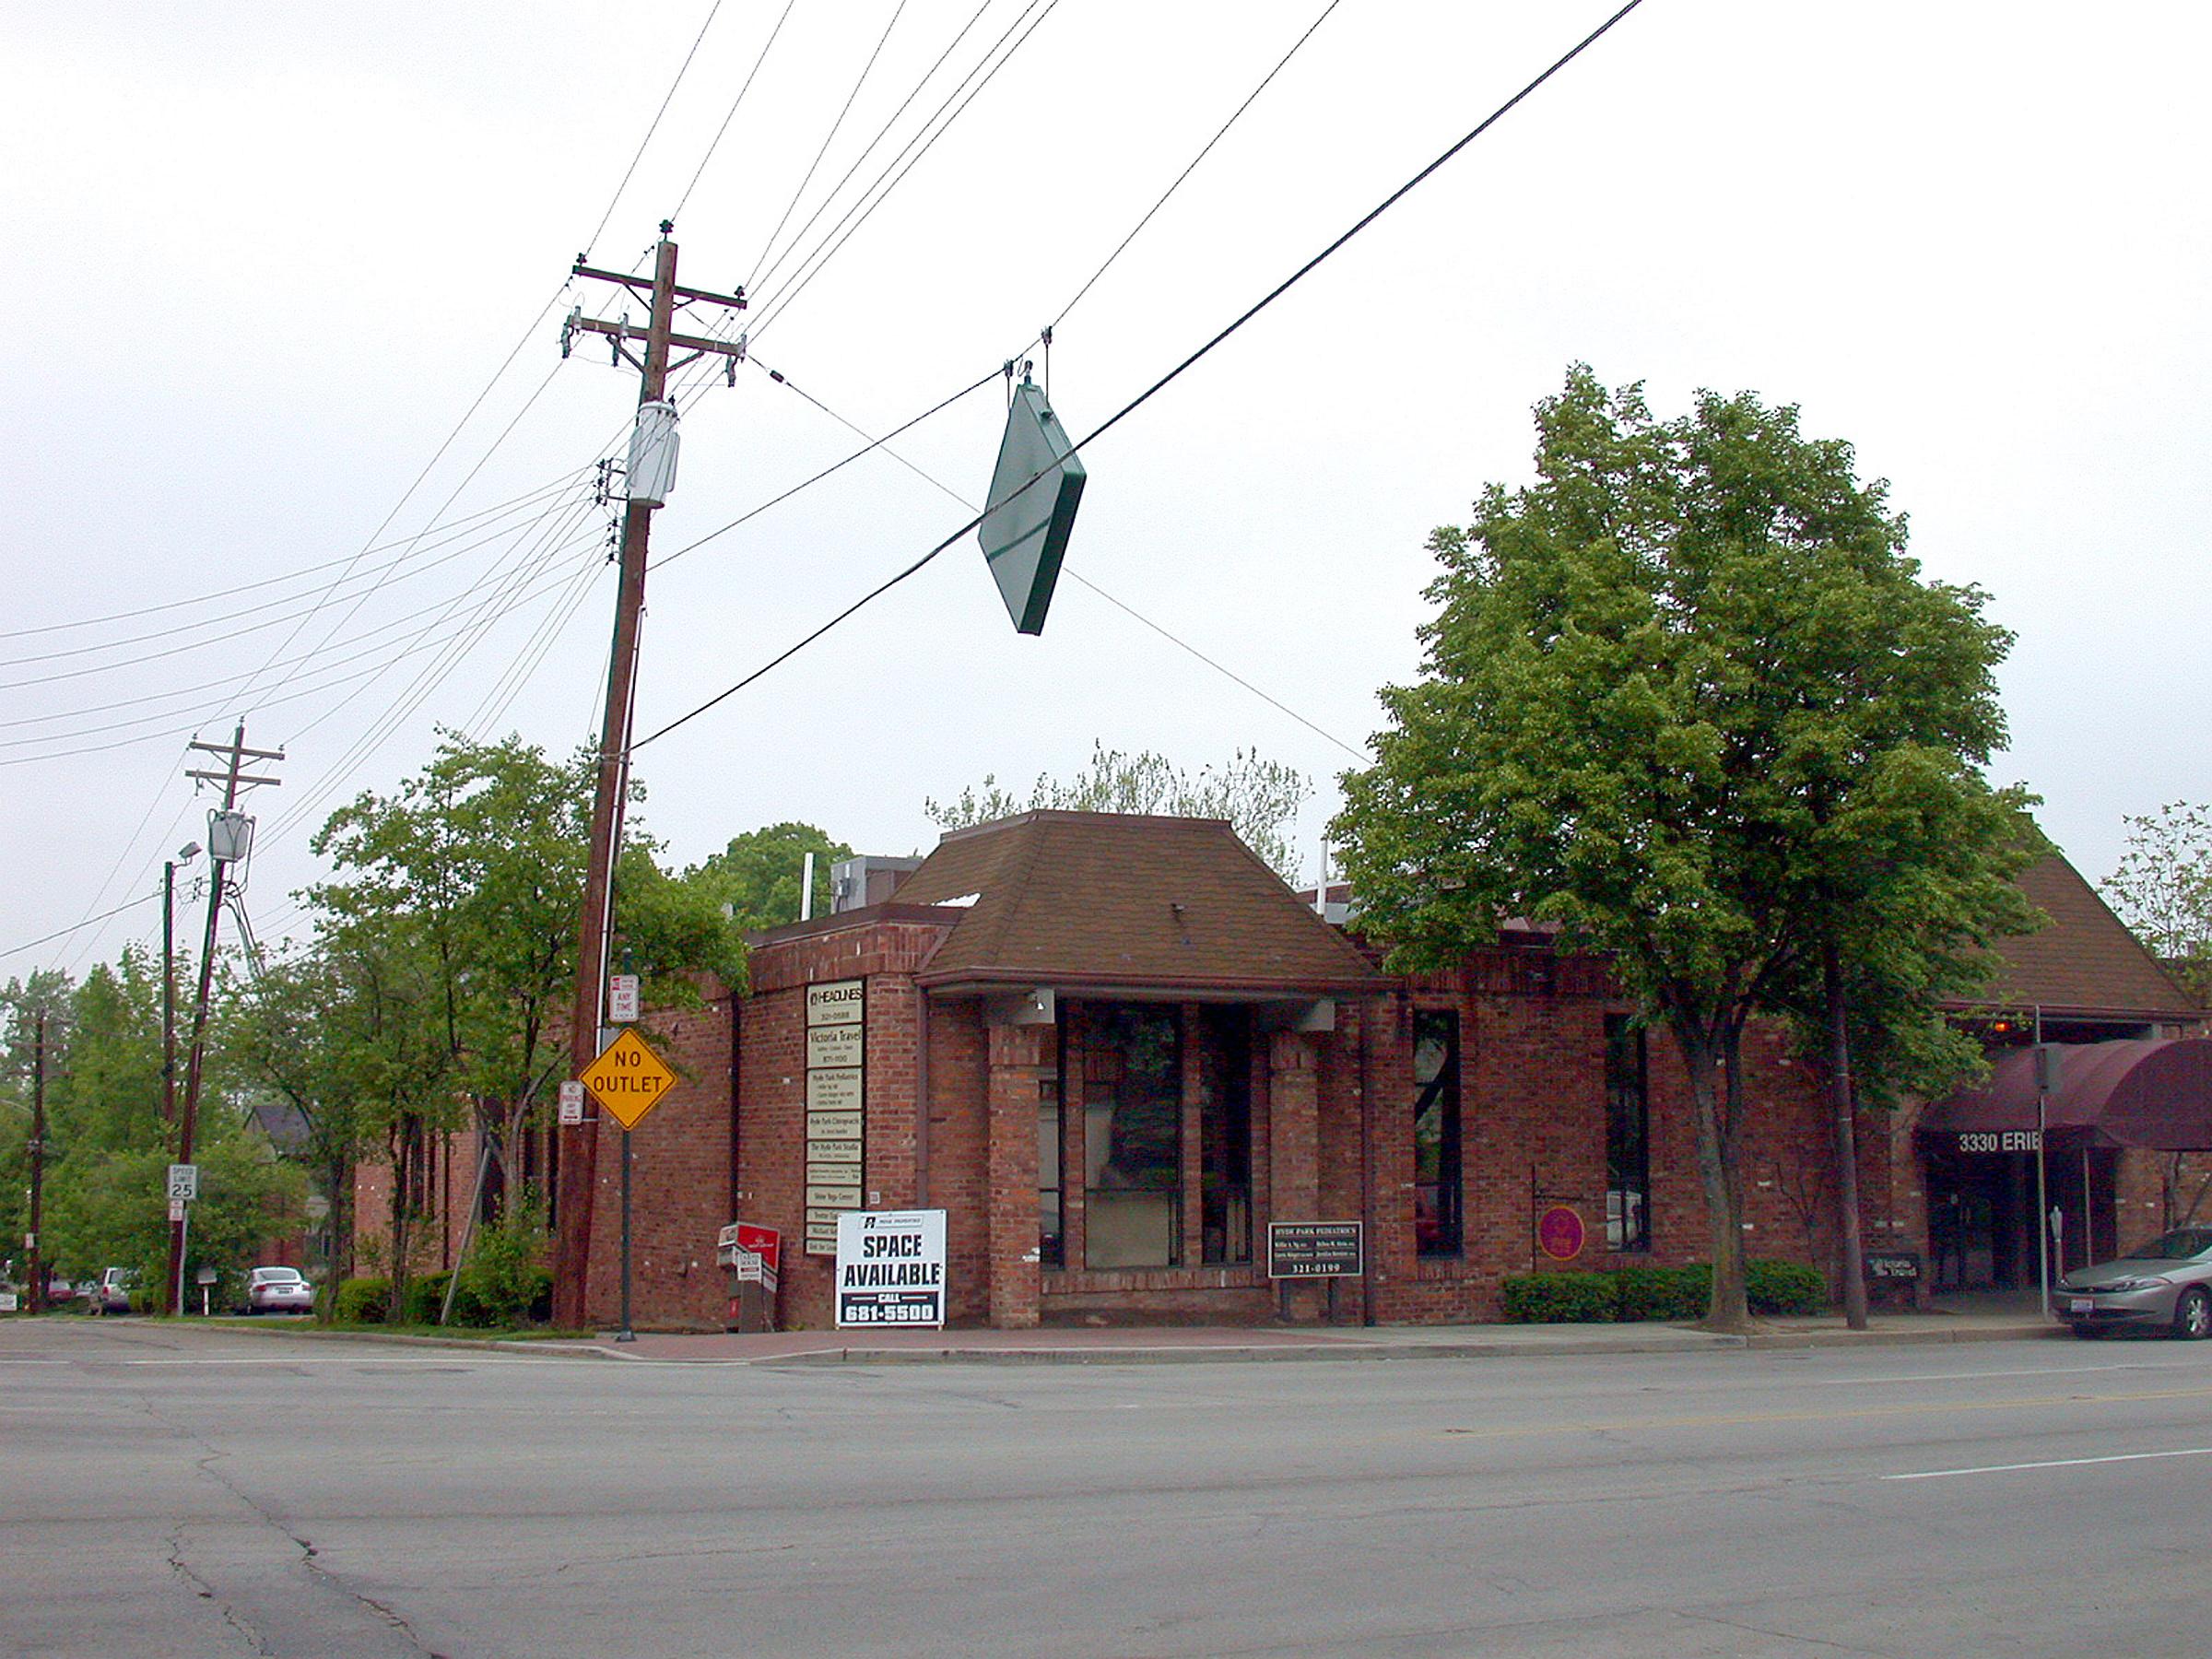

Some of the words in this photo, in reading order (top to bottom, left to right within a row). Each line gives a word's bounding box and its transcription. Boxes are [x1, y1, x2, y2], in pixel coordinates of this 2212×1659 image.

[810, 1030, 837, 1042] Victoria
[840, 1030, 861, 1041] Travel
[615, 1051, 641, 1066] NO
[594, 1077, 662, 1092] OUTLET
[1959, 1133, 1998, 1152] 3330
[2002, 1131, 2041, 1151] ERIE
[172, 1183, 193, 1197] 25
[863, 1234, 922, 1258] SPACE
[843, 1263, 940, 1287] AVAILABLE
[877, 1293, 900, 1303] CALL
